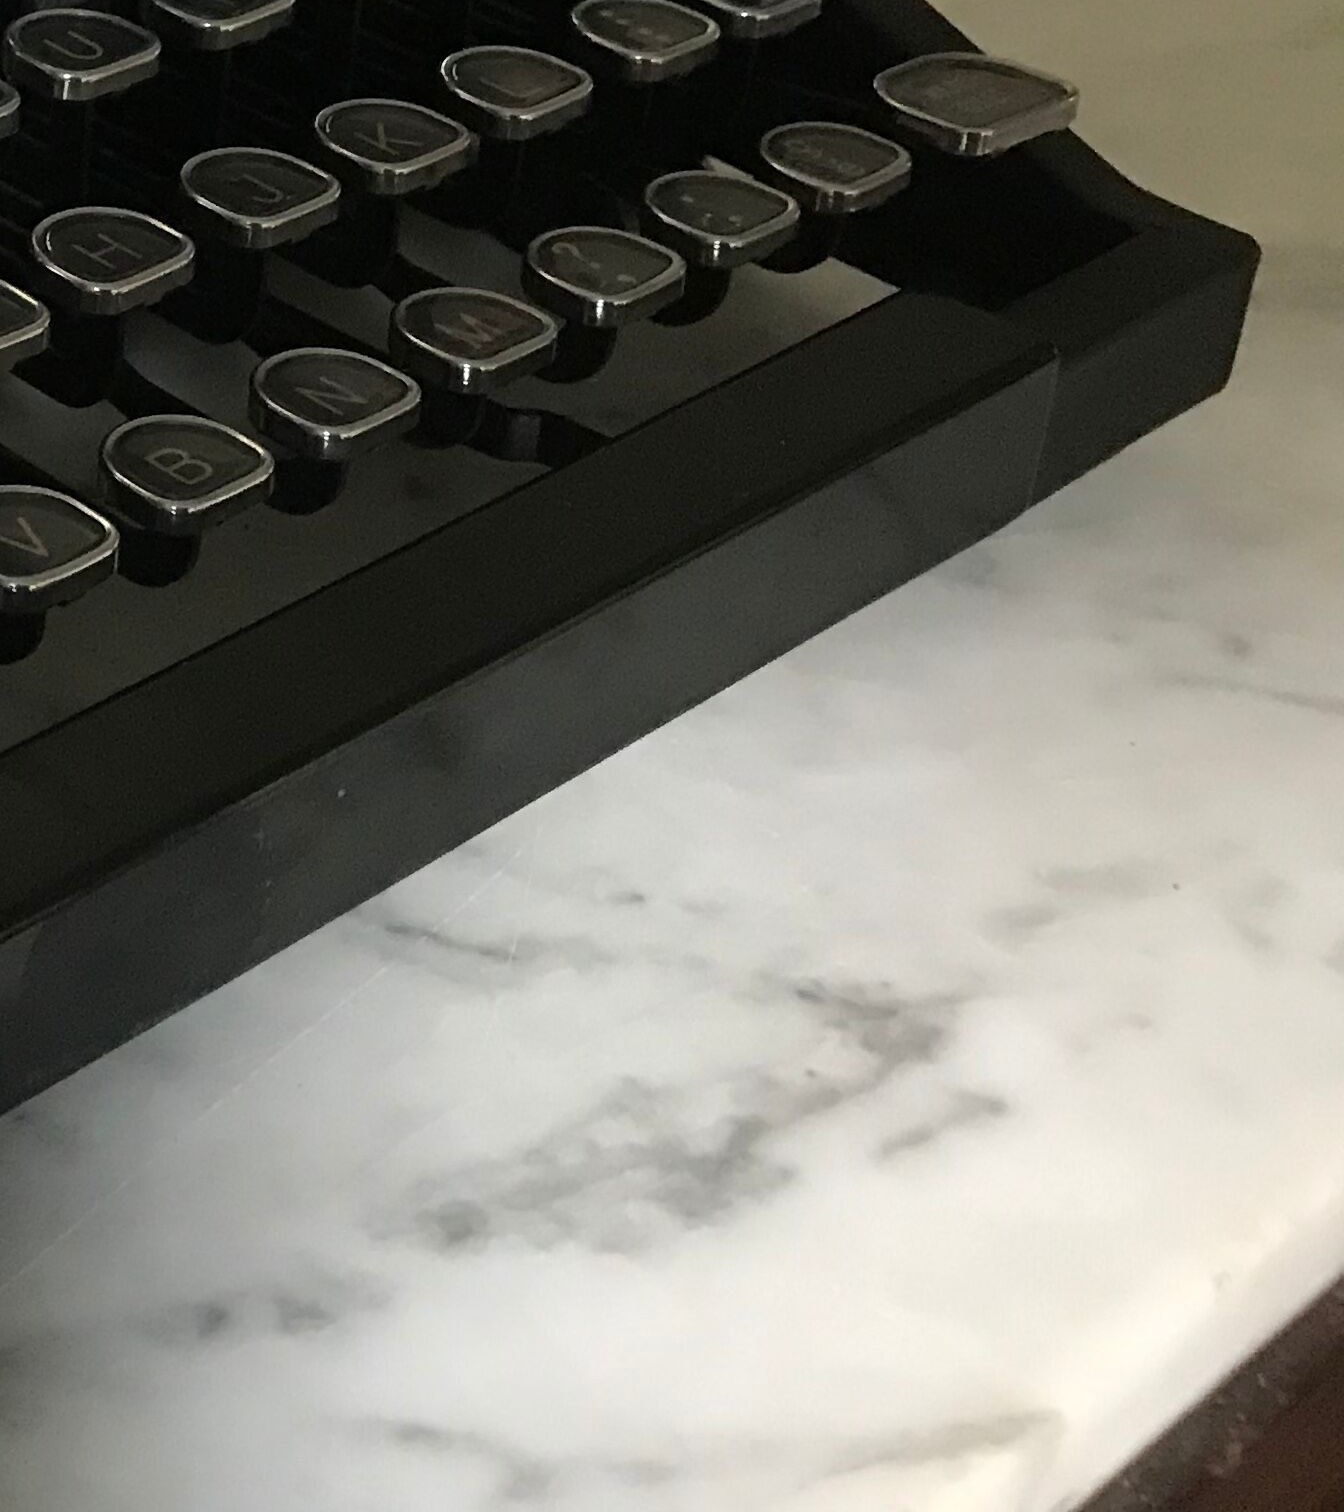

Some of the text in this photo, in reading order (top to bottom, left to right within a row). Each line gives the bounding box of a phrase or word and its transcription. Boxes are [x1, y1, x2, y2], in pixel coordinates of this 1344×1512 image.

[44, 30, 103, 60] U
[354, 120, 422, 156] K
[233, 173, 285, 204] J
[71, 232, 143, 270] H
[433, 311, 501, 350] M
[295, 375, 371, 416] N
[143, 446, 213, 486] B
